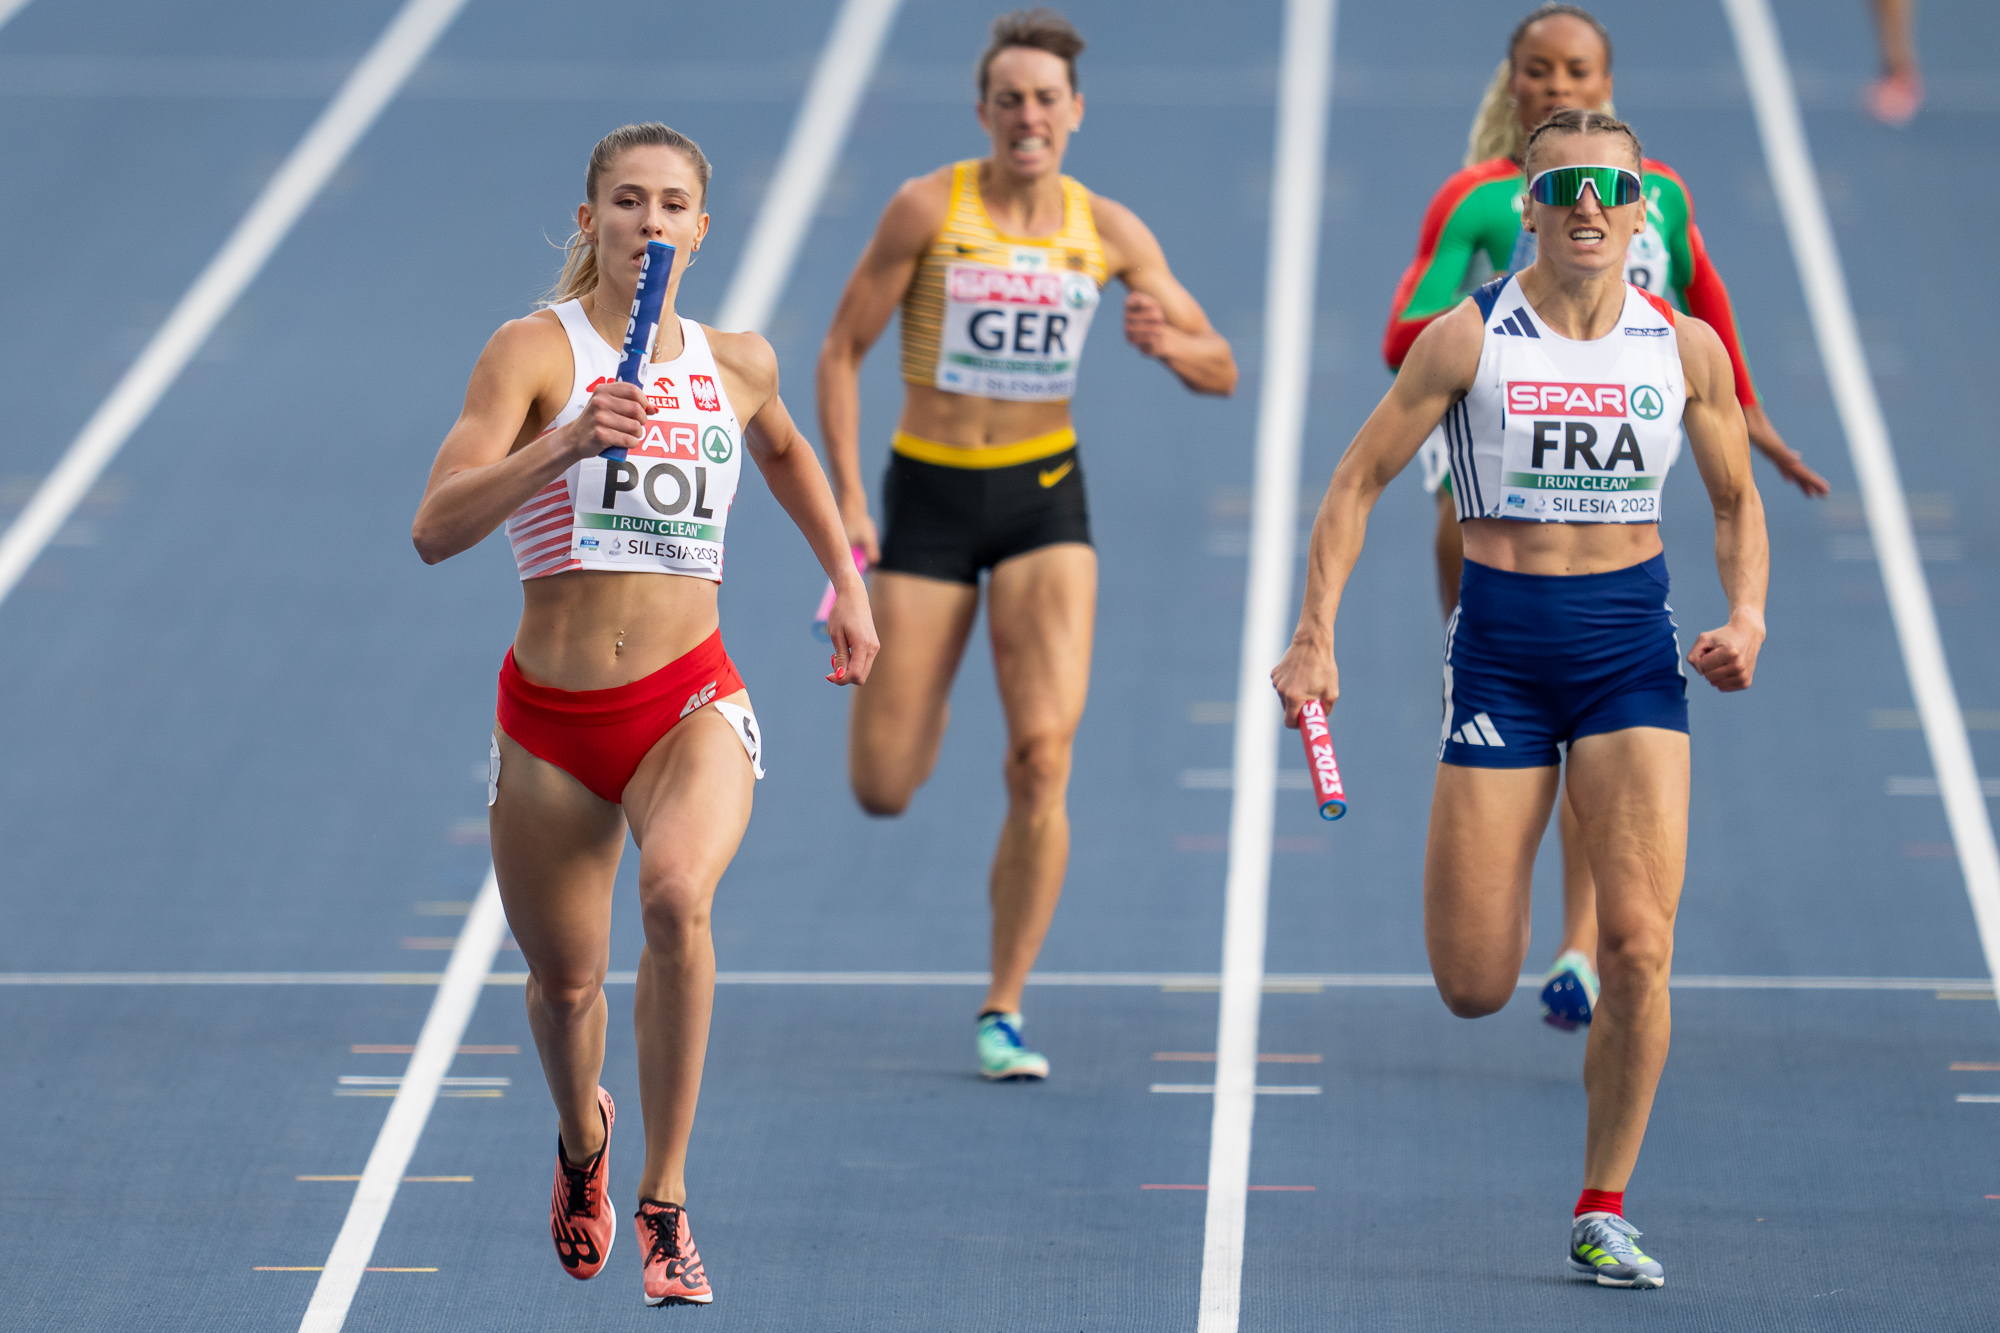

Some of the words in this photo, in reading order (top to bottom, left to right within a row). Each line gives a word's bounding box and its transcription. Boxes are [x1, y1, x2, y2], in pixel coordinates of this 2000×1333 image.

[968, 309, 1069, 355] GER
[648, 397, 677, 409] RLEN
[1510, 384, 1625, 414] SPAR
[1531, 420, 1645, 472] FRA
[601, 459, 714, 520] POL
[1537, 475, 1543, 488] I
[1545, 476, 1578, 489] RUN
[1552, 497, 1617, 513] SILESIA
[1620, 497, 1655, 512] 2023
[612, 516, 617, 529] I
[620, 516, 655, 533] RUN
[627, 538, 694, 560] SILESIA
[1312, 743, 1344, 795] 2023
